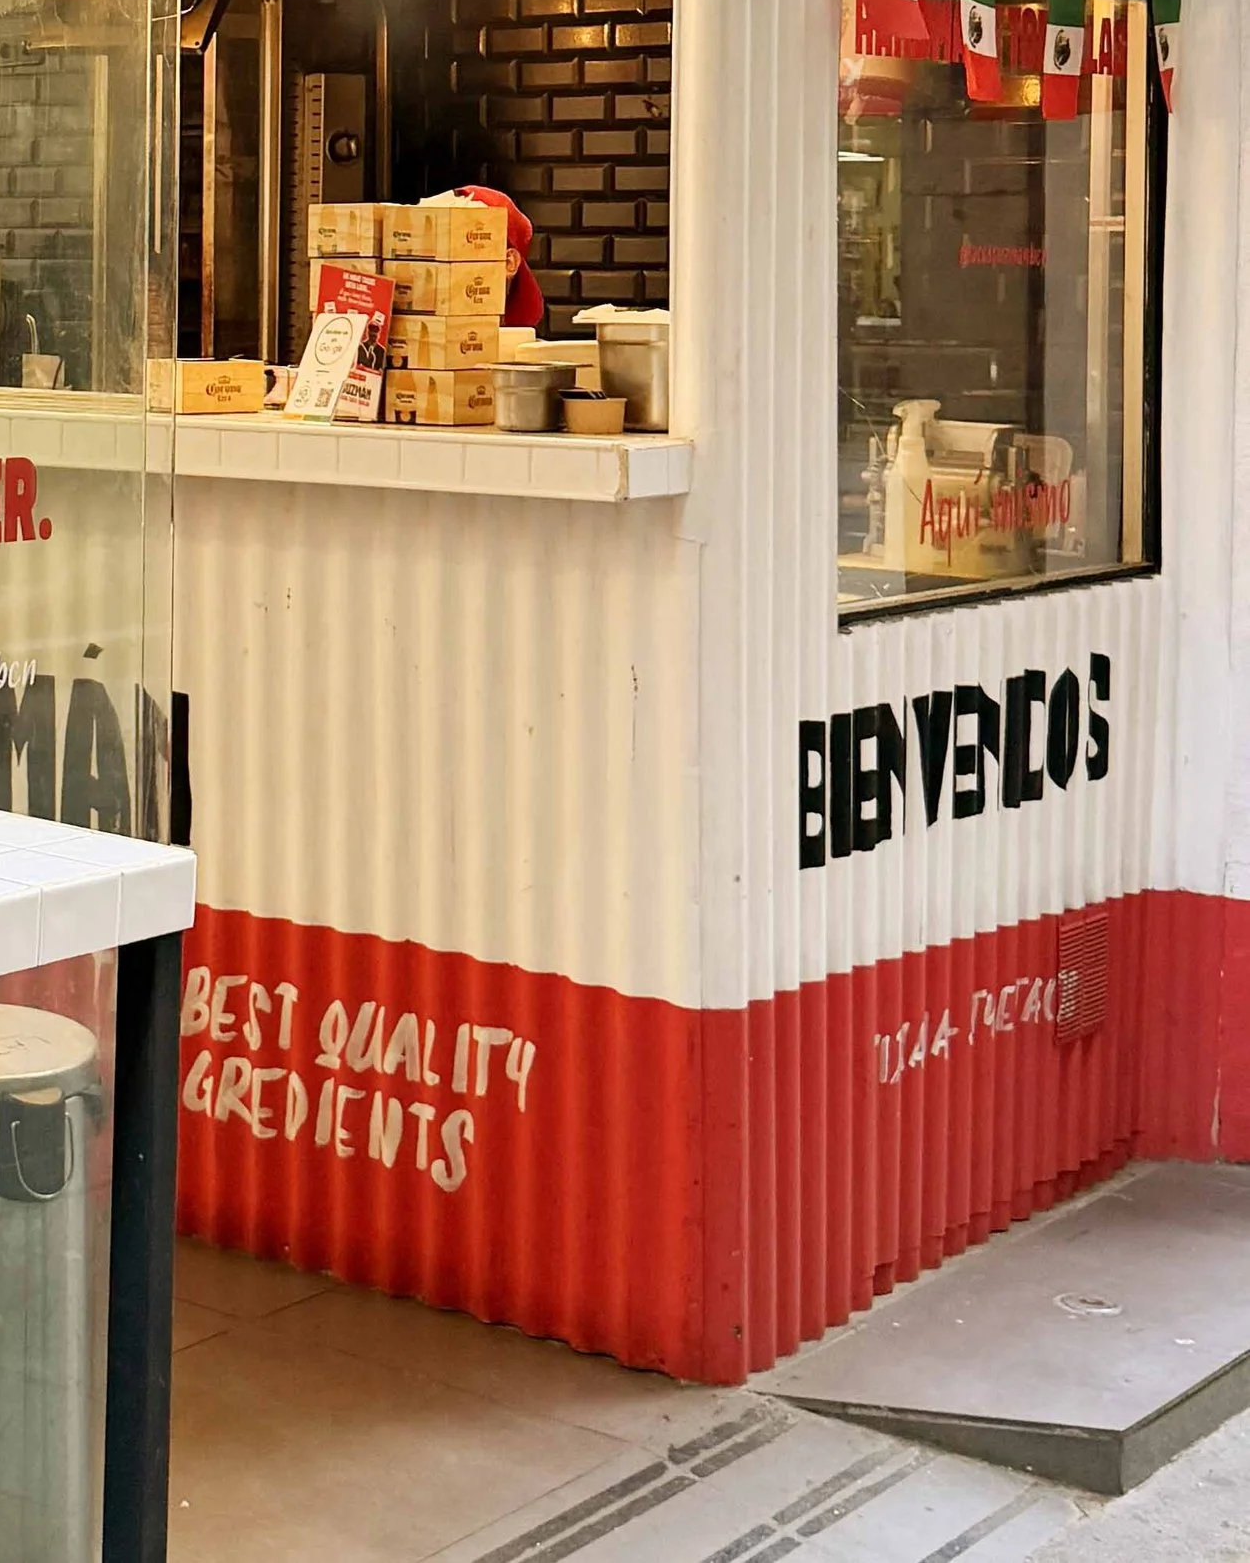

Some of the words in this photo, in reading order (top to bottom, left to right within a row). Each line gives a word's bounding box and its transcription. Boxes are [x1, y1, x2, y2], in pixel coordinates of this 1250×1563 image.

[180, 965, 299, 1051] BEST
[315, 999, 536, 1113] QUALITY
[182, 1049, 475, 1194] GREDIENTS
